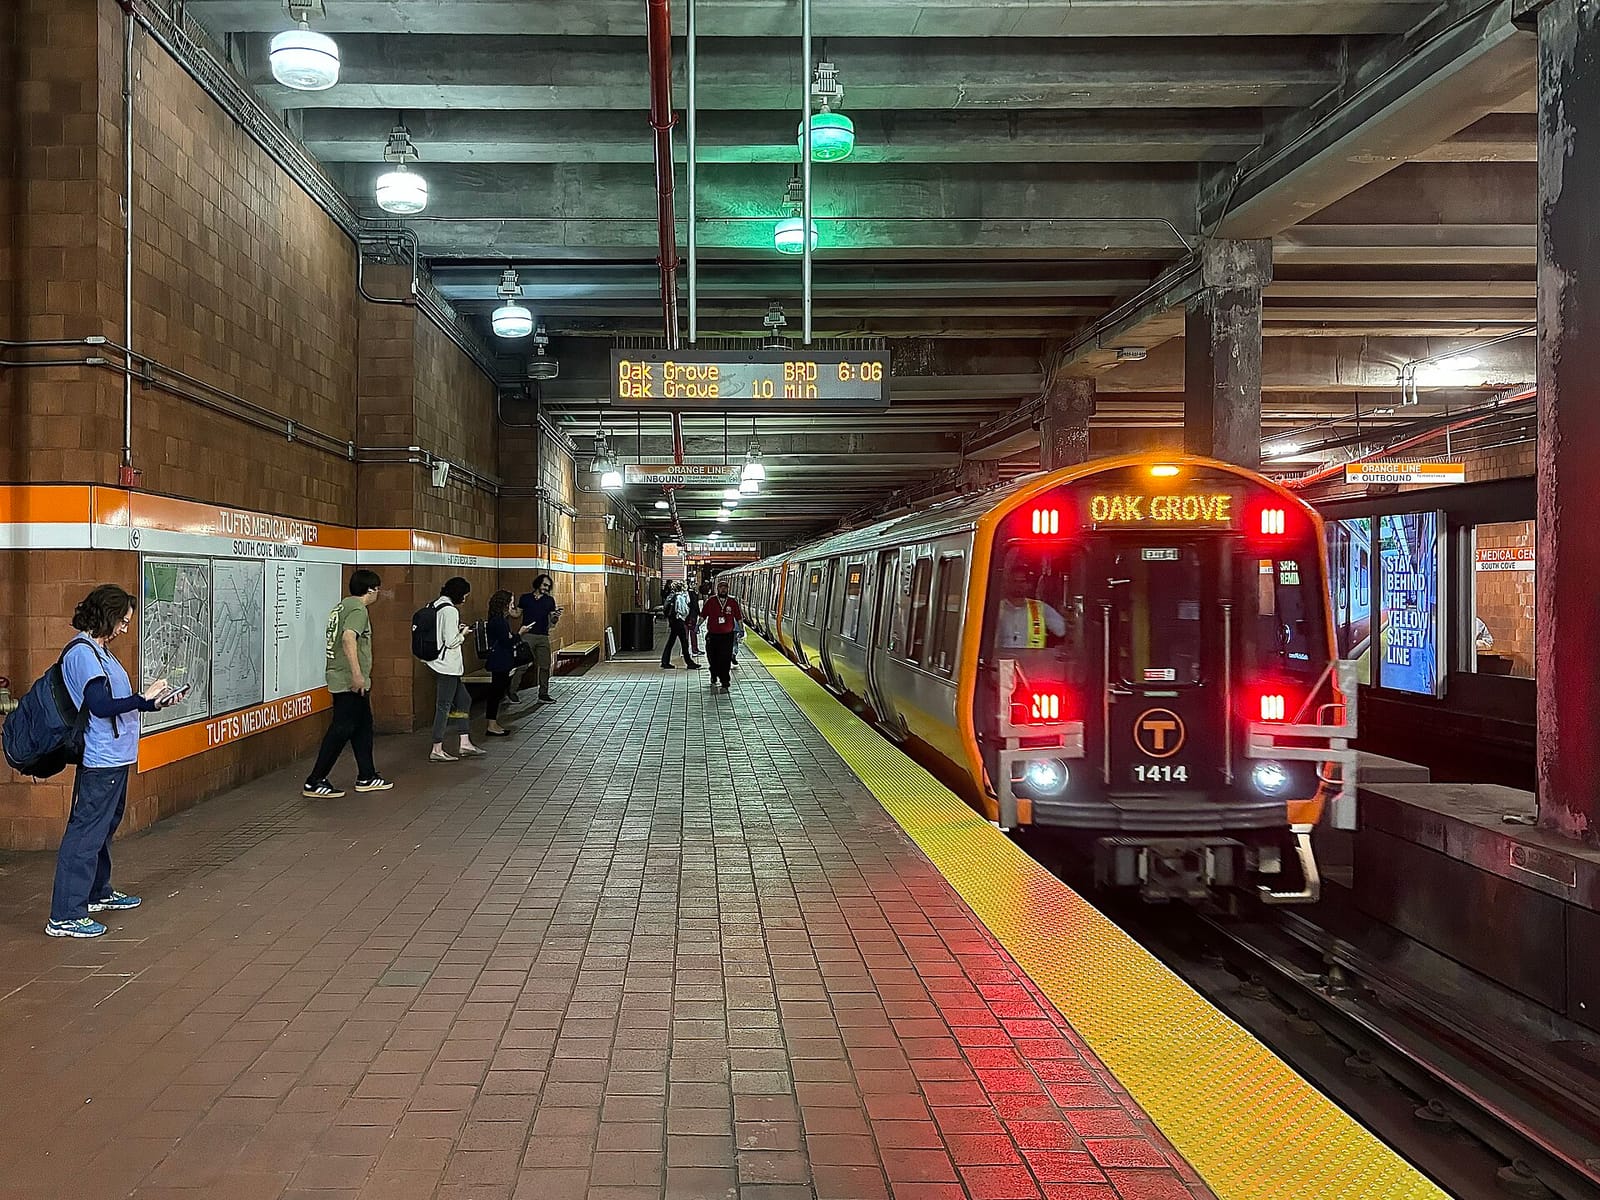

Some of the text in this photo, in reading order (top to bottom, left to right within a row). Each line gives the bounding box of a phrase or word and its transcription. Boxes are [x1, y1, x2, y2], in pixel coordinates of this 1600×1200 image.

[619, 360, 883, 381] Oak Grove BRD 6:06
[619, 379, 818, 399] Oak Grove 10 min
[667, 465, 727, 474] ORANGE LINE
[1362, 464, 1422, 473] ORANGE LINE
[643, 475, 684, 483] INBOUND
[1362, 474, 1412, 482] OUTBOUND
[1090, 495, 1232, 520] OAK GROVE
[220, 511, 318, 543] TUFTS MEDICAL CENTER
[233, 540, 299, 558] SOUTH COVE INBOUND
[1481, 550, 1517, 561] MEDICAL
[1387, 555, 1412, 573] STAY
[1481, 562, 1499, 570] SOUTH
[1387, 573, 1426, 591] BEHIND
[1387, 592, 1407, 609] THE
[1388, 610, 1428, 629] YELLOW
[1387, 628, 1426, 648] SAFETY
[1387, 647, 1410, 666] LINE
[206, 694, 312, 745] TUFTS MEDICAL CENTER
[1134, 765, 1188, 782] 1414
